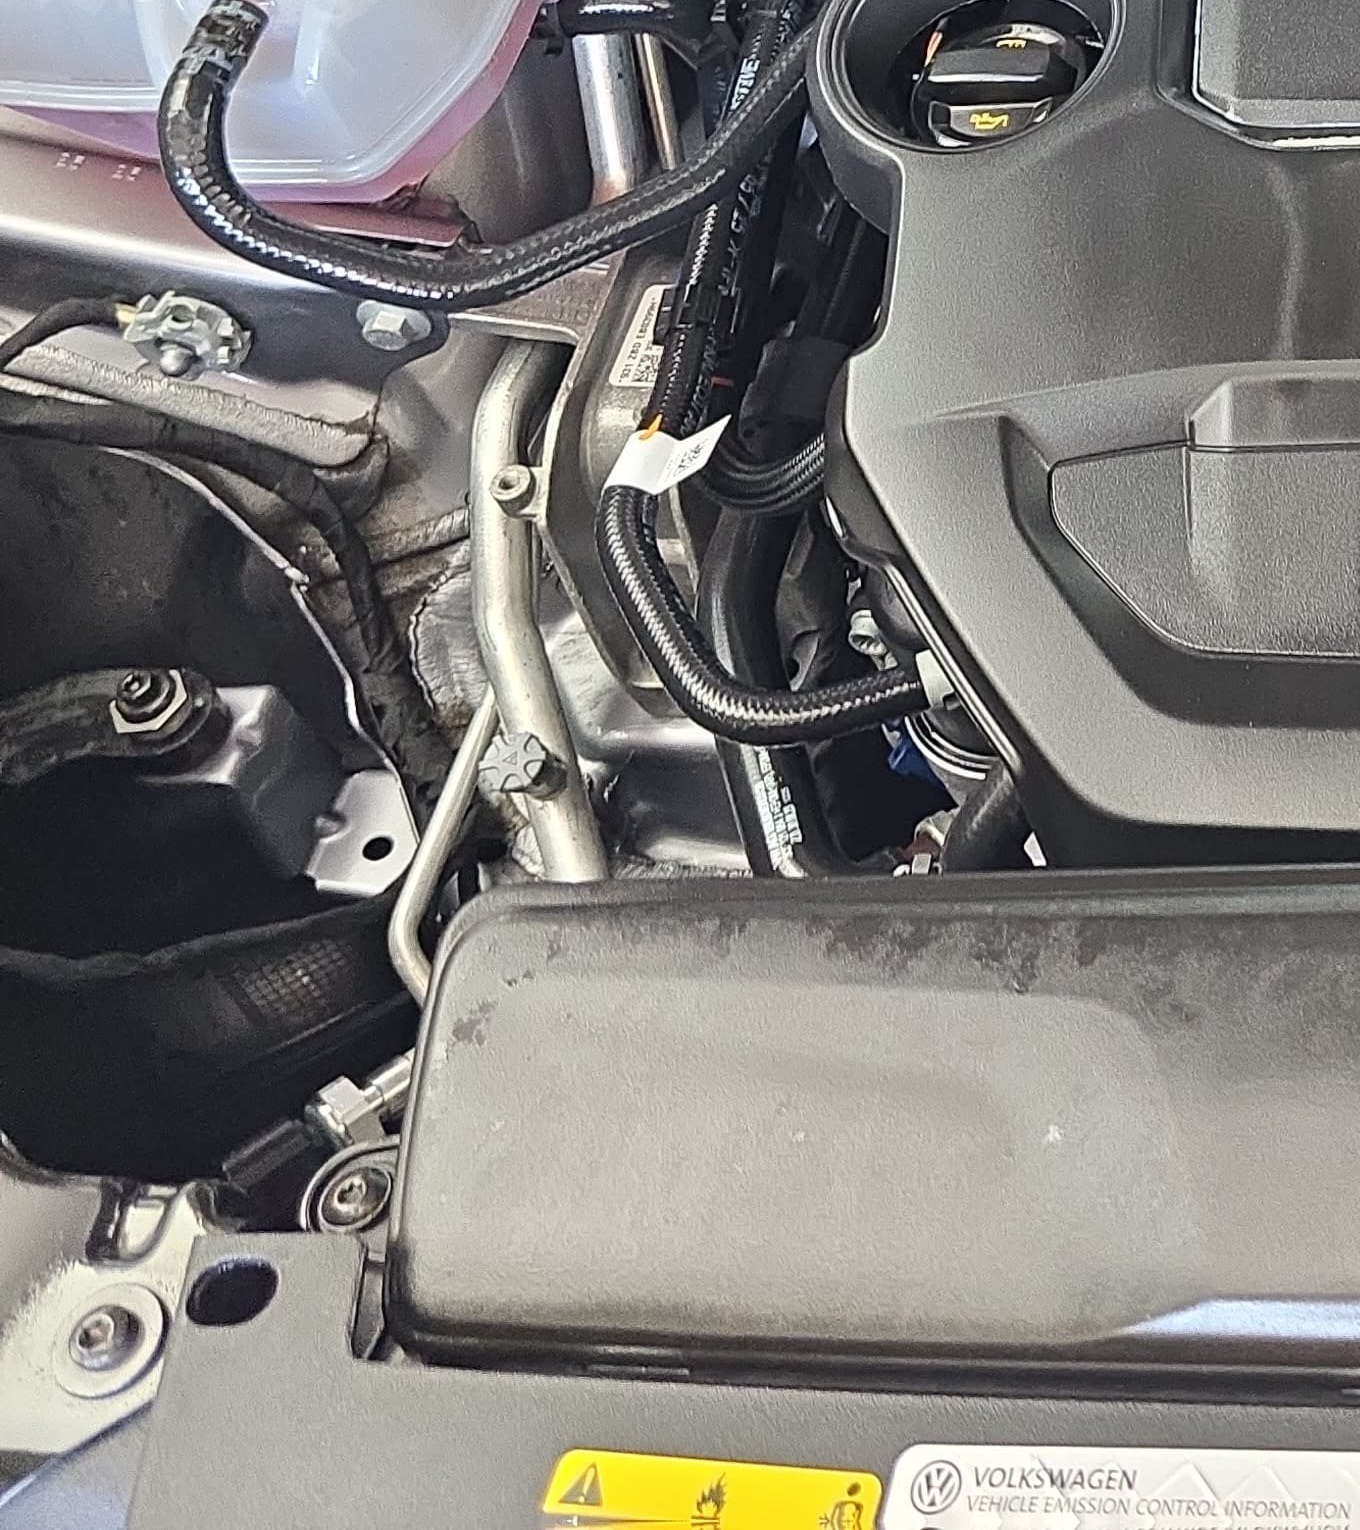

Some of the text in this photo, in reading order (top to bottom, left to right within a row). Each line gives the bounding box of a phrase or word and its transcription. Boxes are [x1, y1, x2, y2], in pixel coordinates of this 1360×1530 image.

[973, 1466, 1138, 1491] VOLKSWAGEN
[967, 1495, 1352, 1520] VEHICLE EMISSION CONTROL INFORMATION
